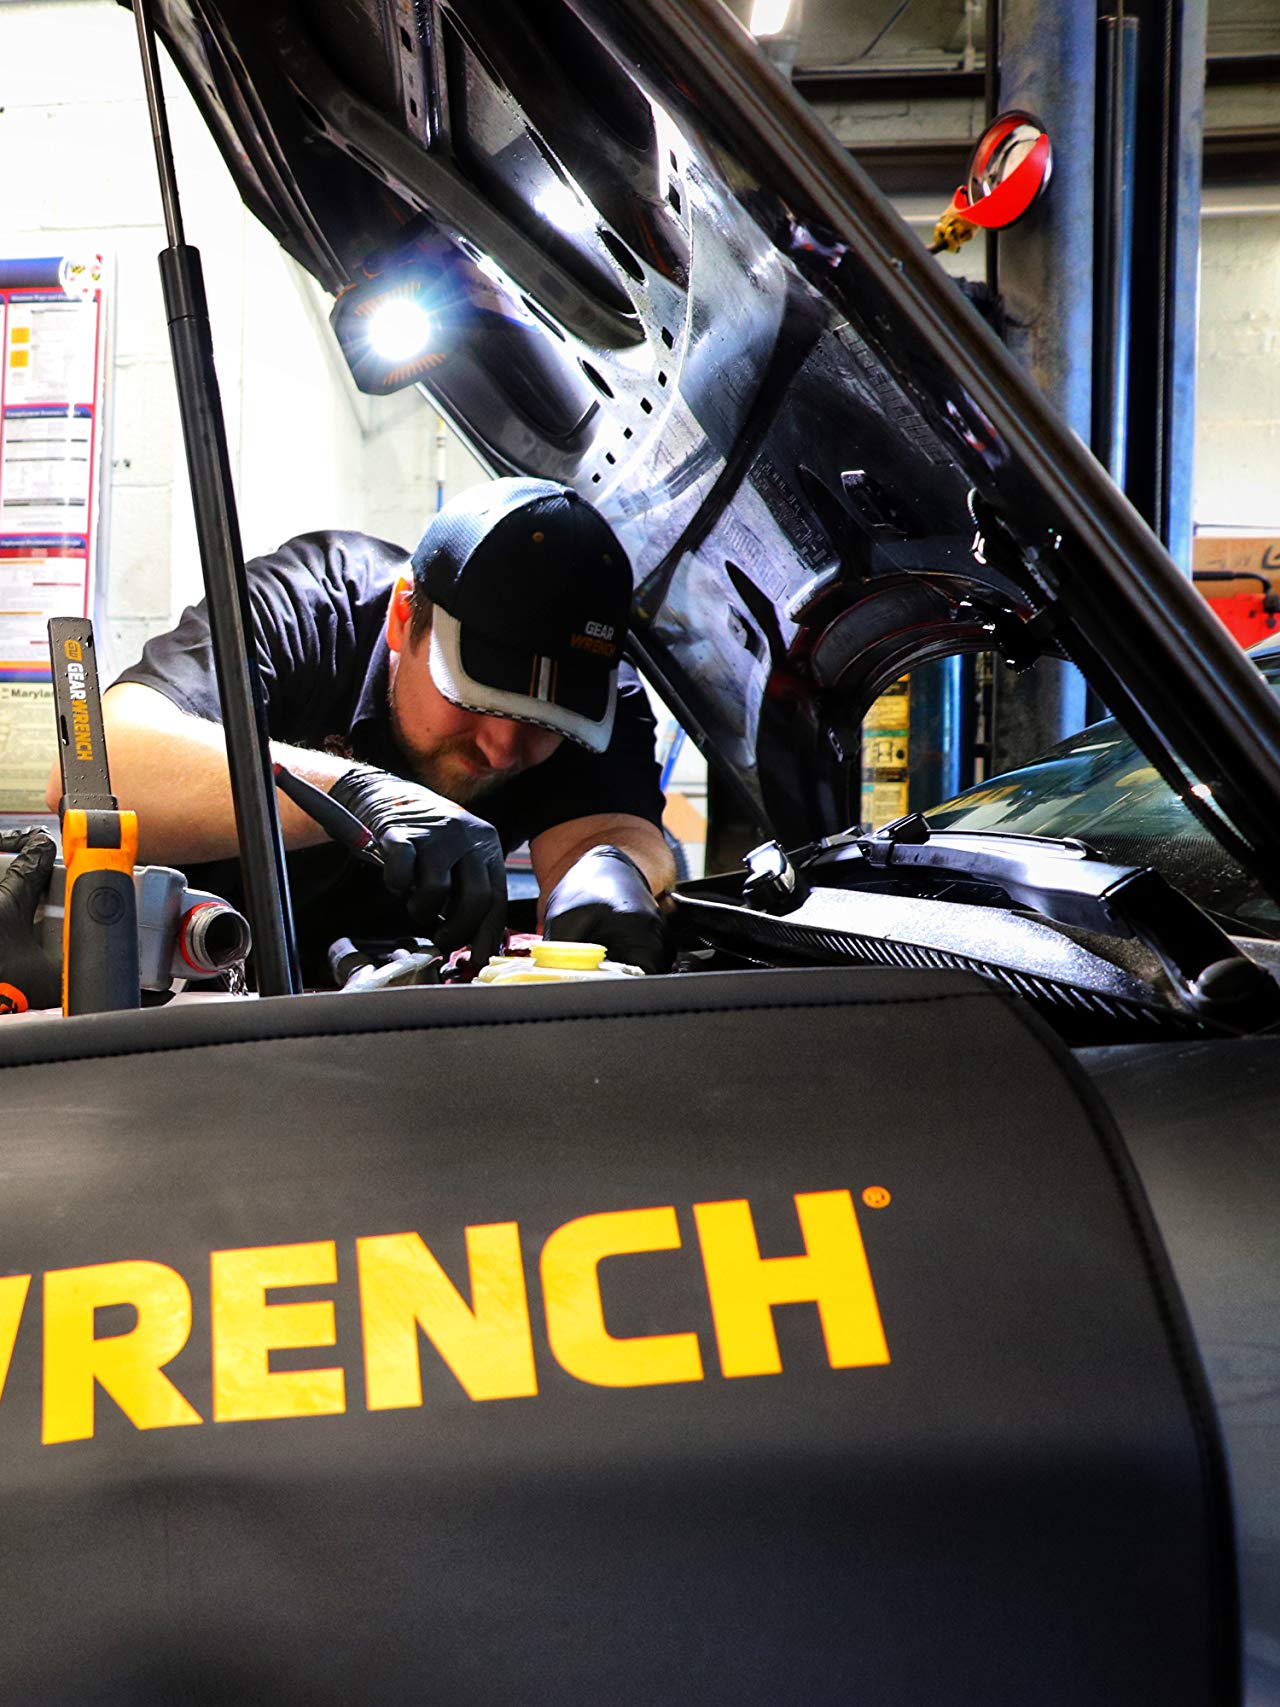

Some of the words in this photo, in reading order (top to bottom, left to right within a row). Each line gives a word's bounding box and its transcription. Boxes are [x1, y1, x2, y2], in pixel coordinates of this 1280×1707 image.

[585, 620, 614, 640] GEAR
[11, 688, 55, 699] Maryla
[67, 662, 94, 761] GEARWRENCH
